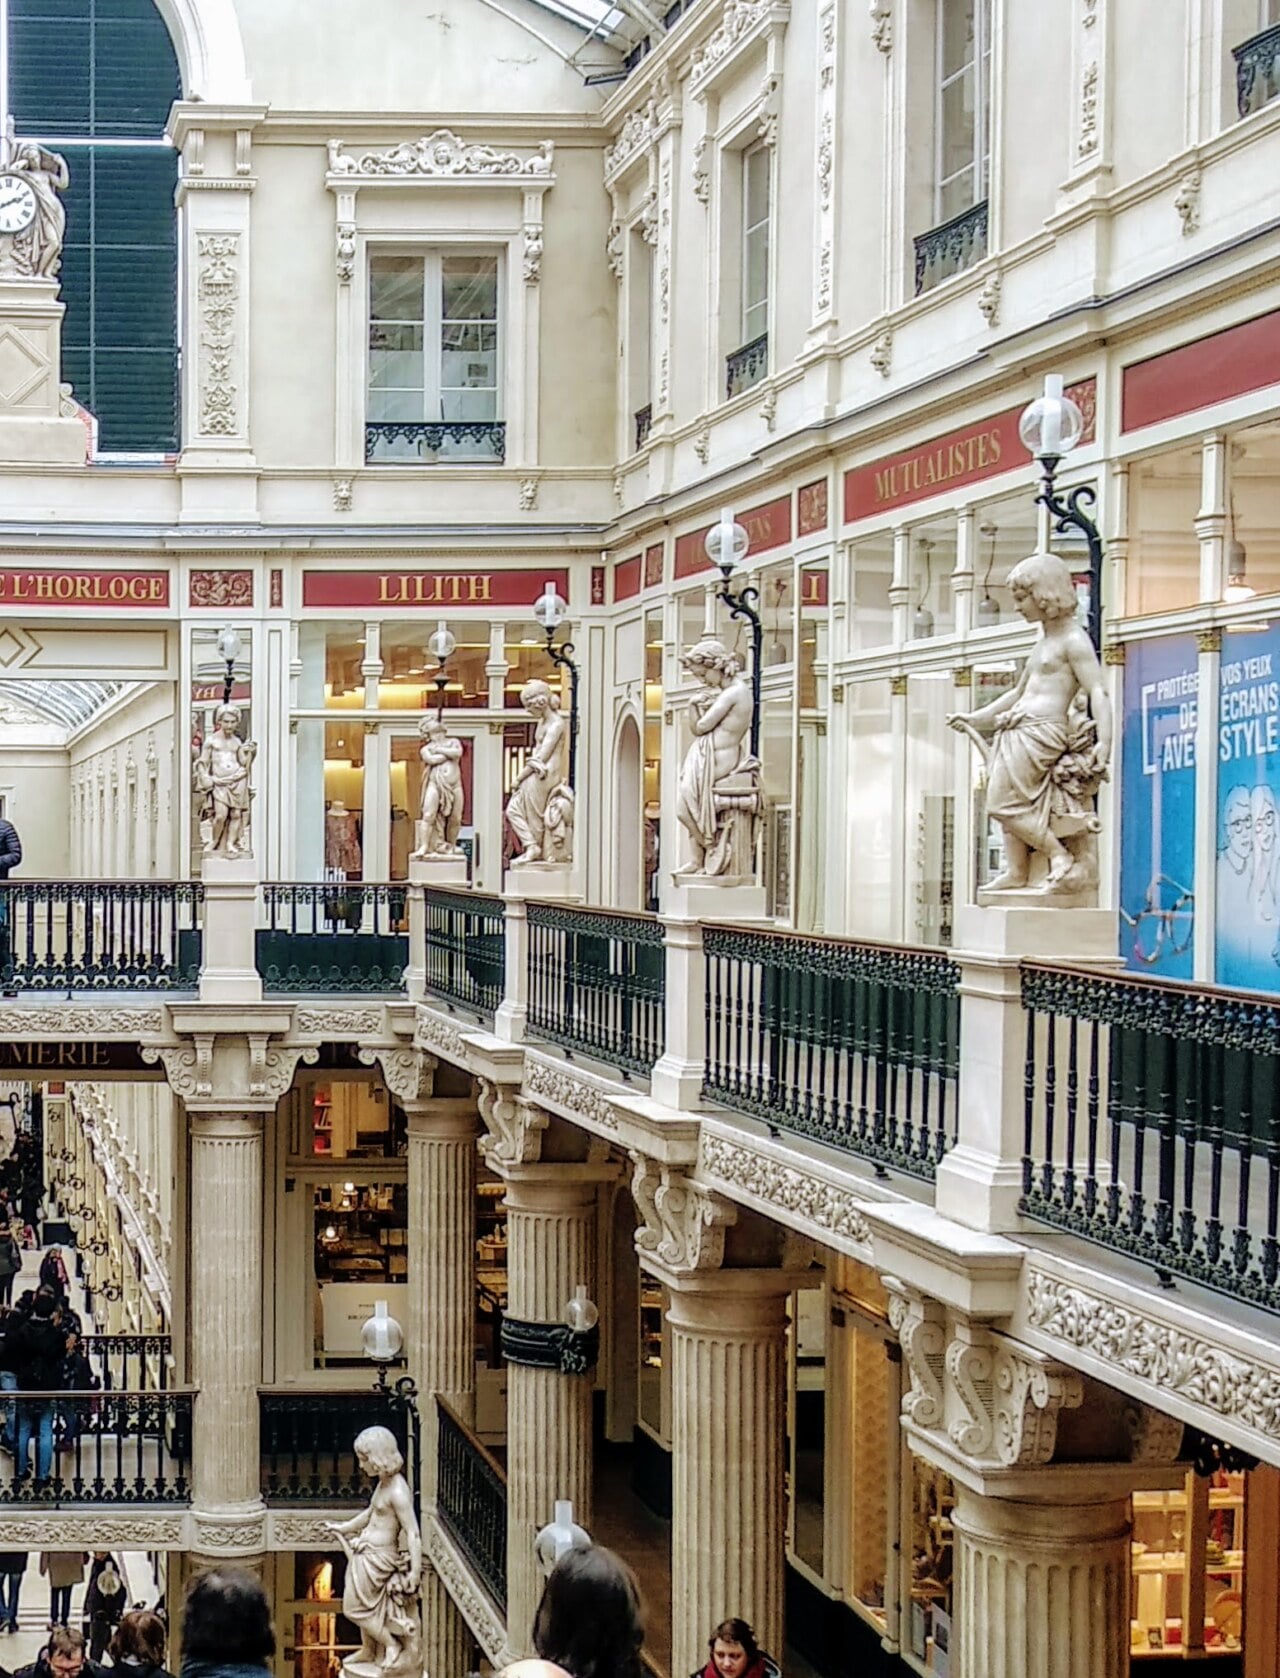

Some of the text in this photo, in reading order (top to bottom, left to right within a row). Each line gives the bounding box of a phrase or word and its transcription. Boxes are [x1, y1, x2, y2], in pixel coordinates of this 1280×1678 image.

[874, 428, 1001, 501] MUTUALISTES
[13, 574, 165, 600] L'HORLOGE
[378, 575, 492, 601] LILITH
[1157, 654, 1272, 701] PROTÉGE VOS YEUX
[1179, 682, 1279, 731] DE ÉCRANS
[1163, 715, 1279, 771] AVE STYLE
